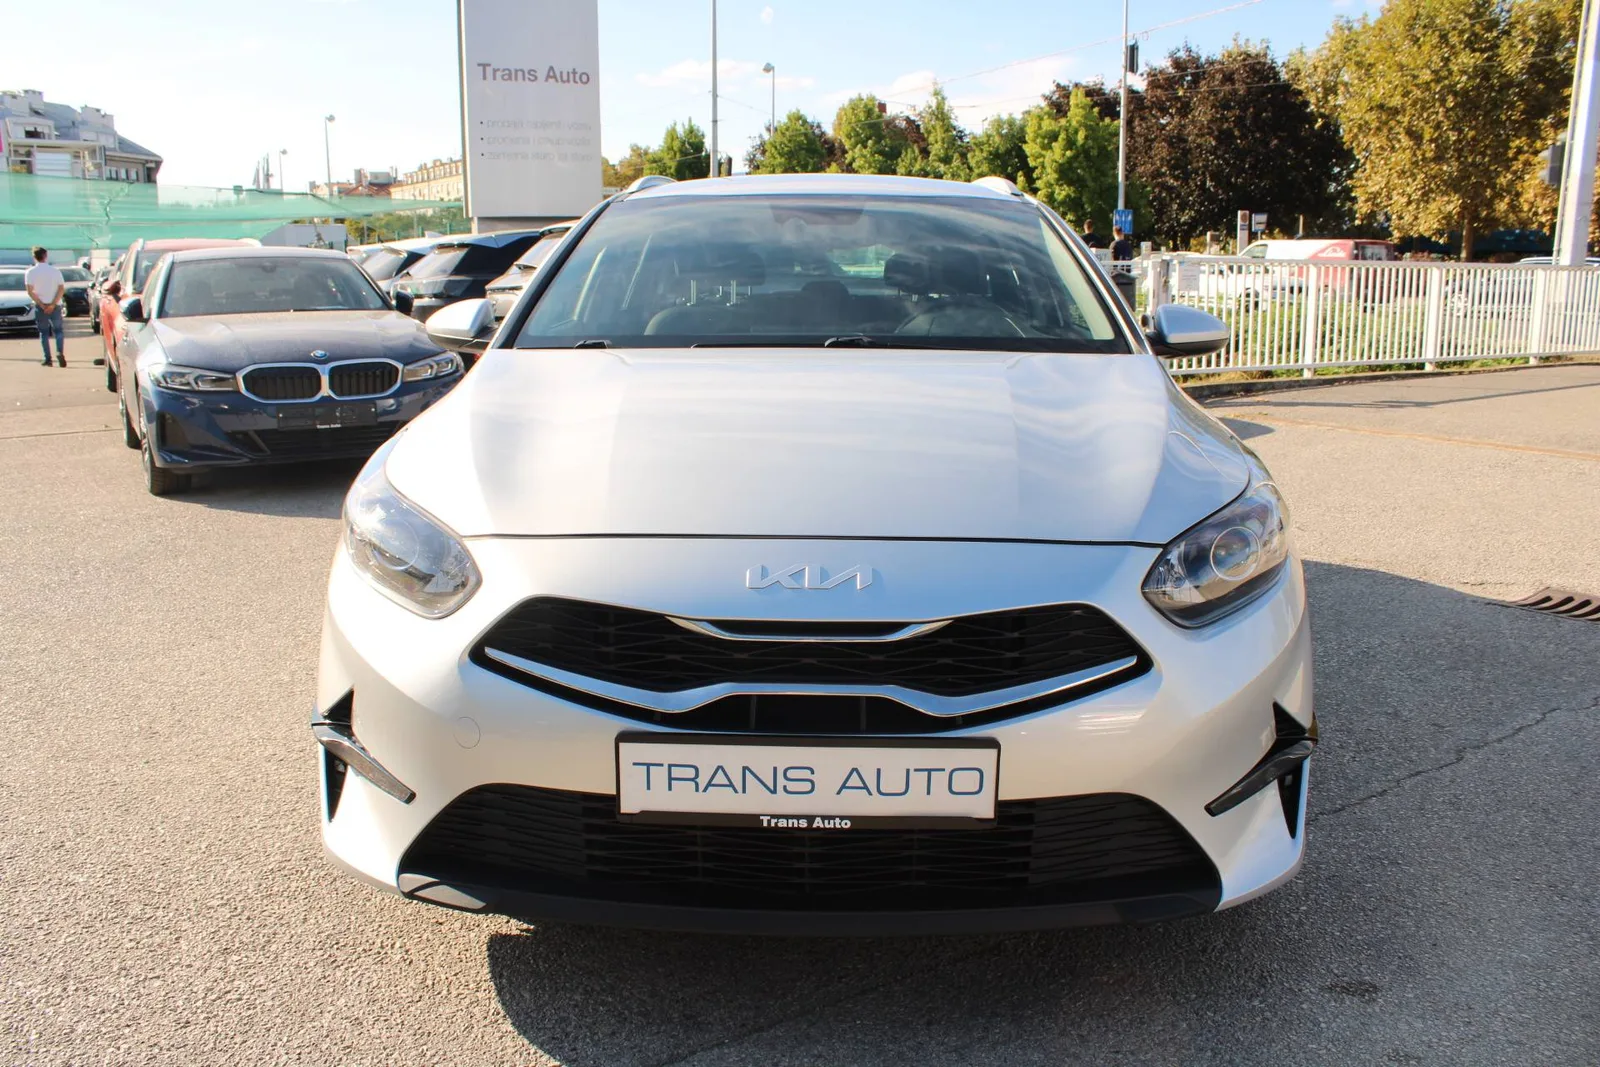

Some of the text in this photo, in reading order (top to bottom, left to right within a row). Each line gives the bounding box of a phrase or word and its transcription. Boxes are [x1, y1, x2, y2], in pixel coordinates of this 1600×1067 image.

[477, 62, 590, 85] Trans Auto
[746, 564, 872, 590] KIA
[632, 761, 985, 797] TRANS AUTO
[760, 815, 852, 829] Trans Auto
